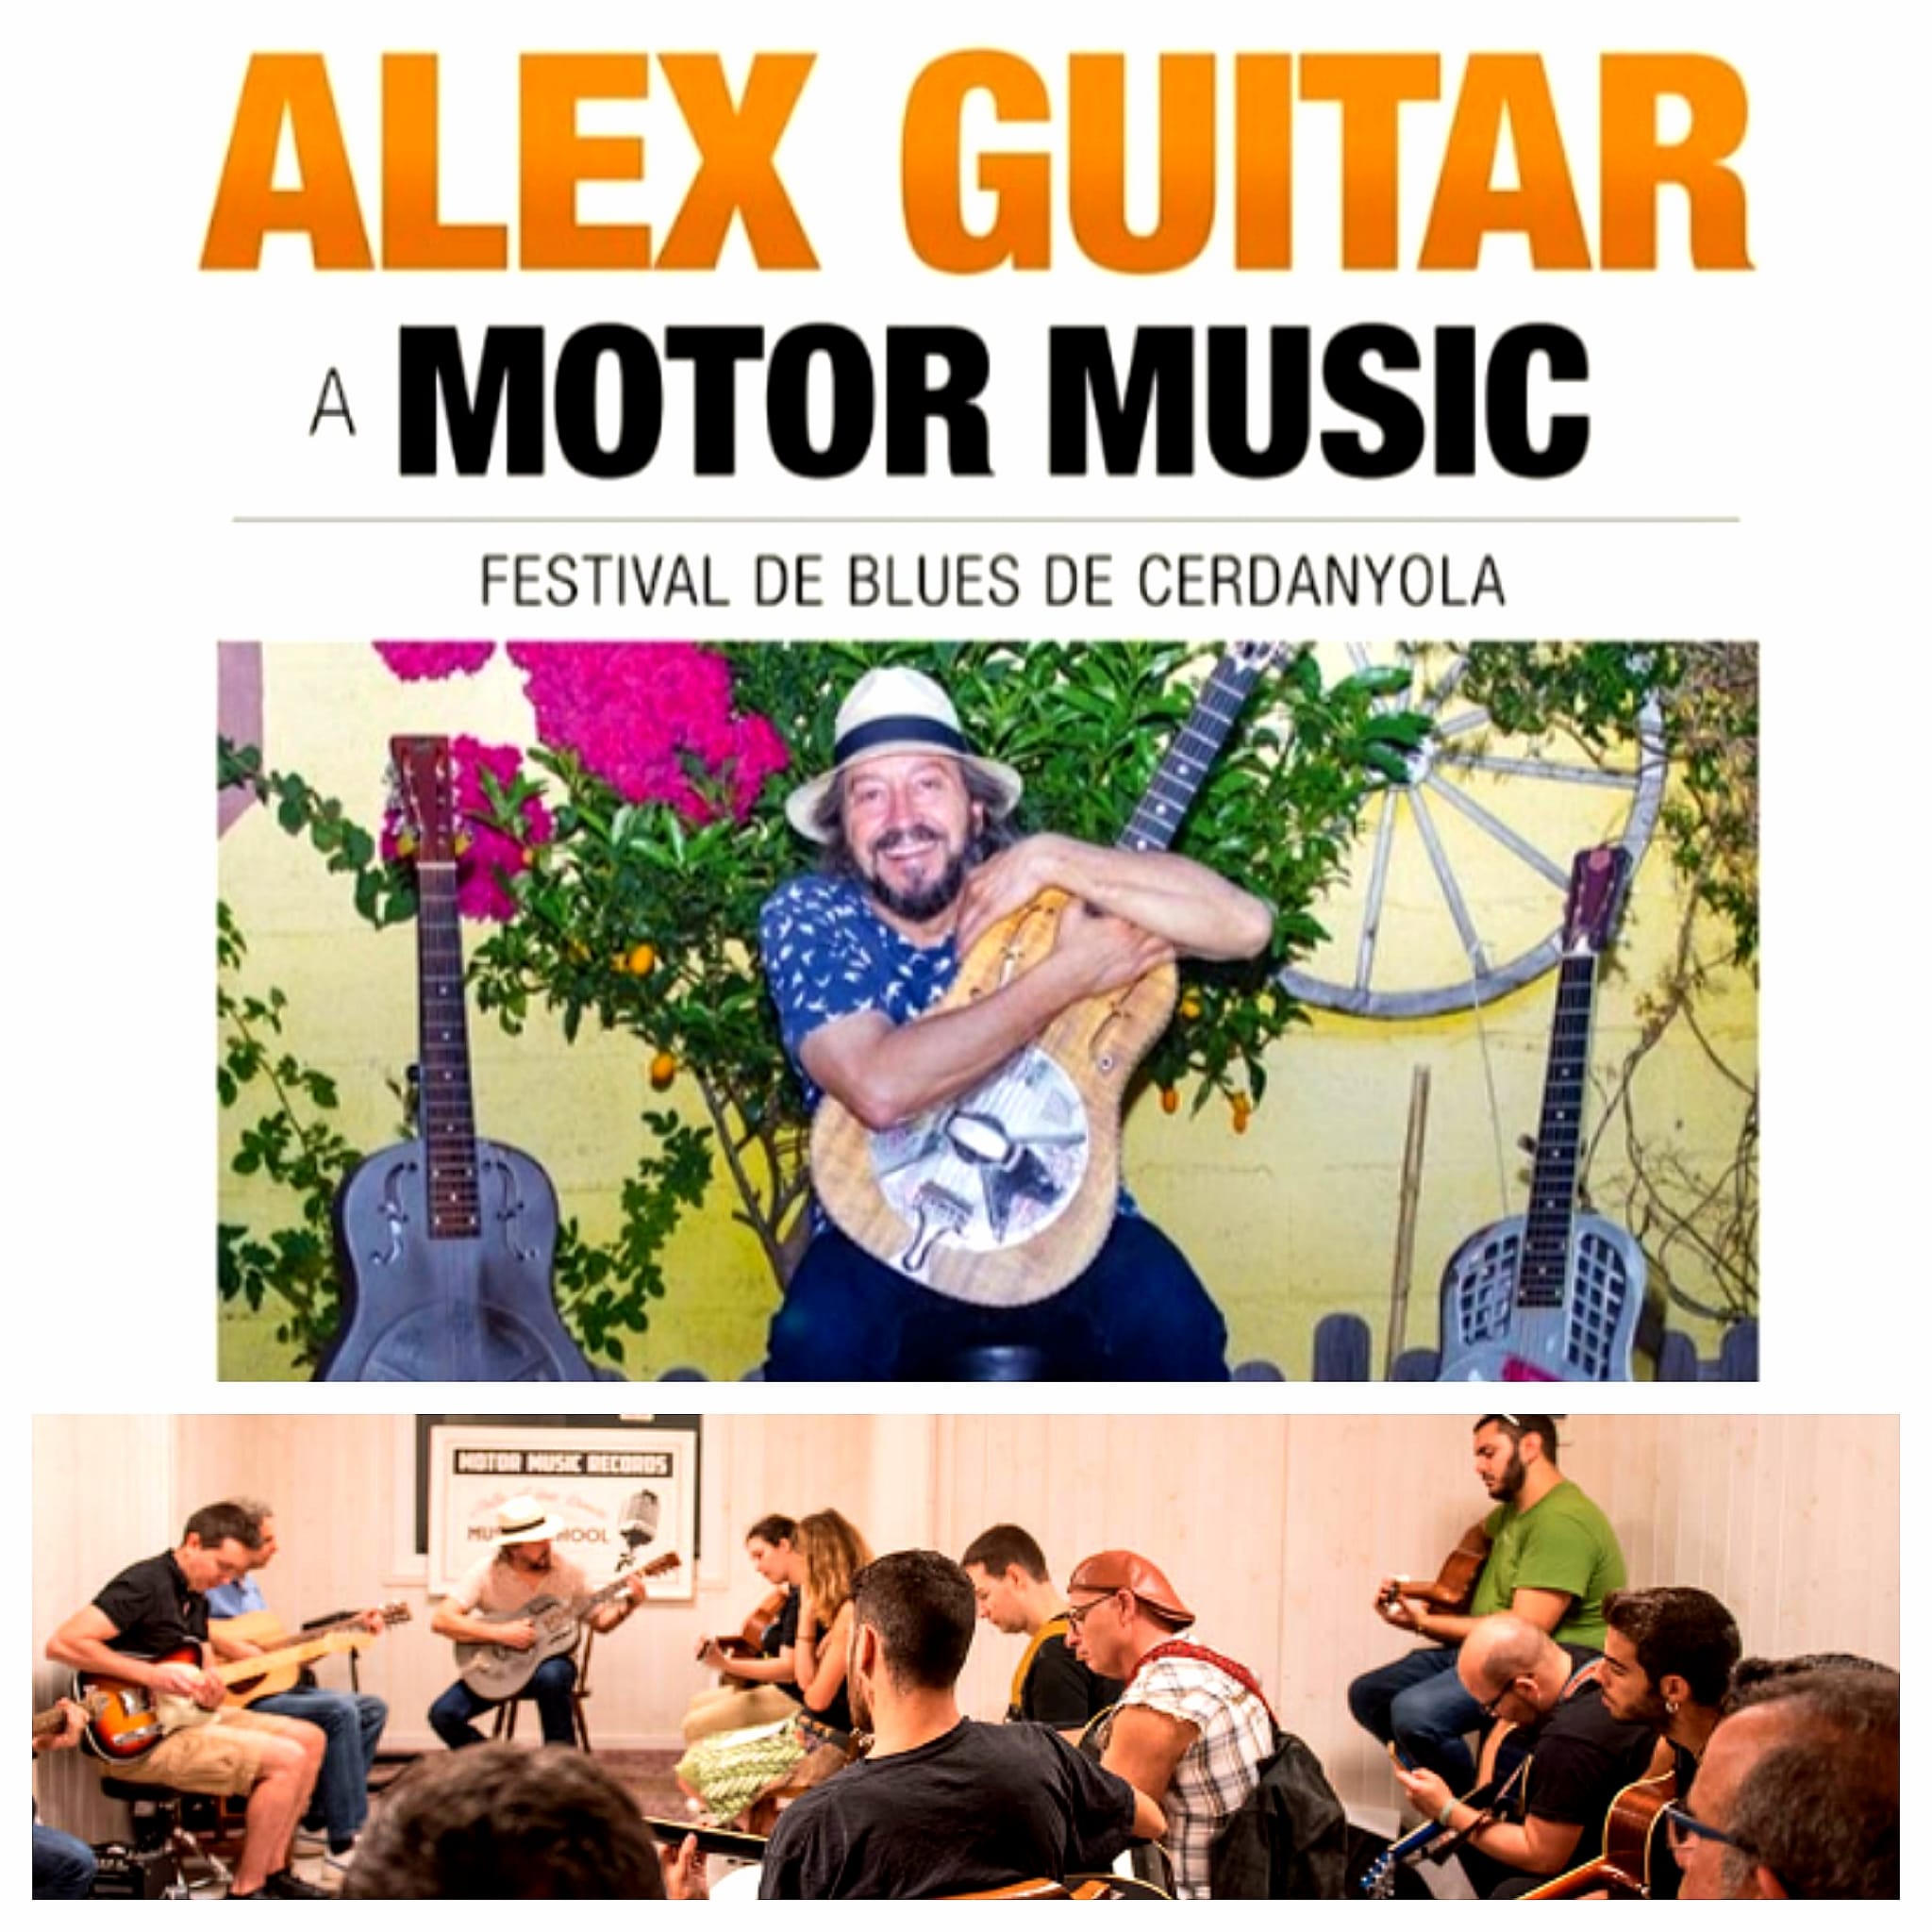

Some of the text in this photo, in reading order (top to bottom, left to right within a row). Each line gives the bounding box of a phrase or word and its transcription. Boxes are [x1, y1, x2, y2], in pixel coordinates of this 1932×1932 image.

[199, 47, 1755, 275] ALEX GUITAR
[309, 323, 1590, 479] A MOTOR MUSIC
[481, 554, 1506, 607] FESTIVAL DE BLUES DE CERDANYOLA
[459, 1453, 667, 1474] MOTOR MUSIC RECORDS
[555, 1526, 610, 1544] HOOL
